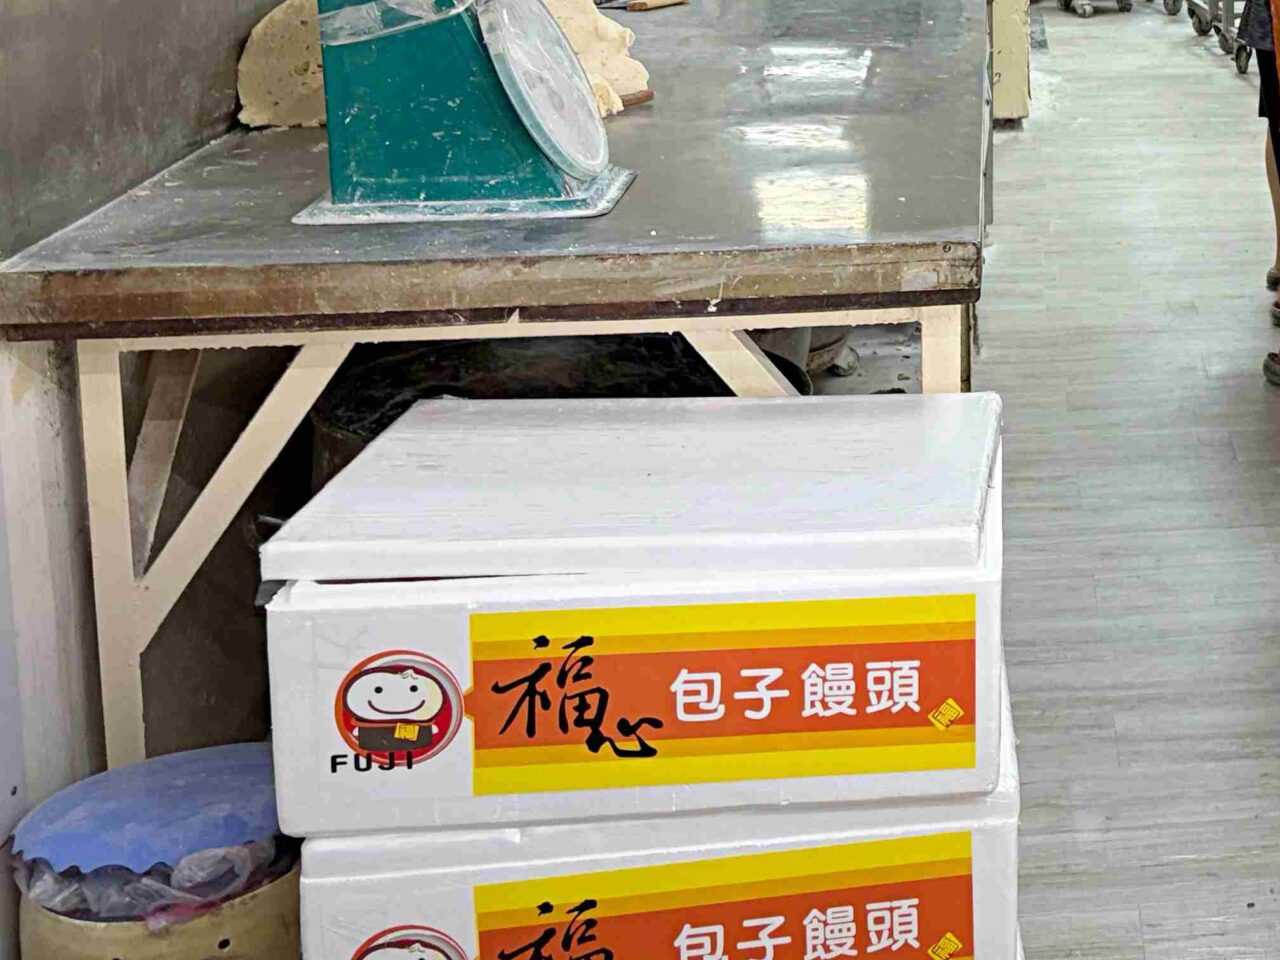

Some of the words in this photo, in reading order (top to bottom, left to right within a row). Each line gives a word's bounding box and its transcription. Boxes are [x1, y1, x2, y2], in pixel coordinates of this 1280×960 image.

[670, 660, 922, 722] 包子饅頭
[330, 750, 414, 773] FUJI
[673, 898, 920, 960] 包子饅頭
